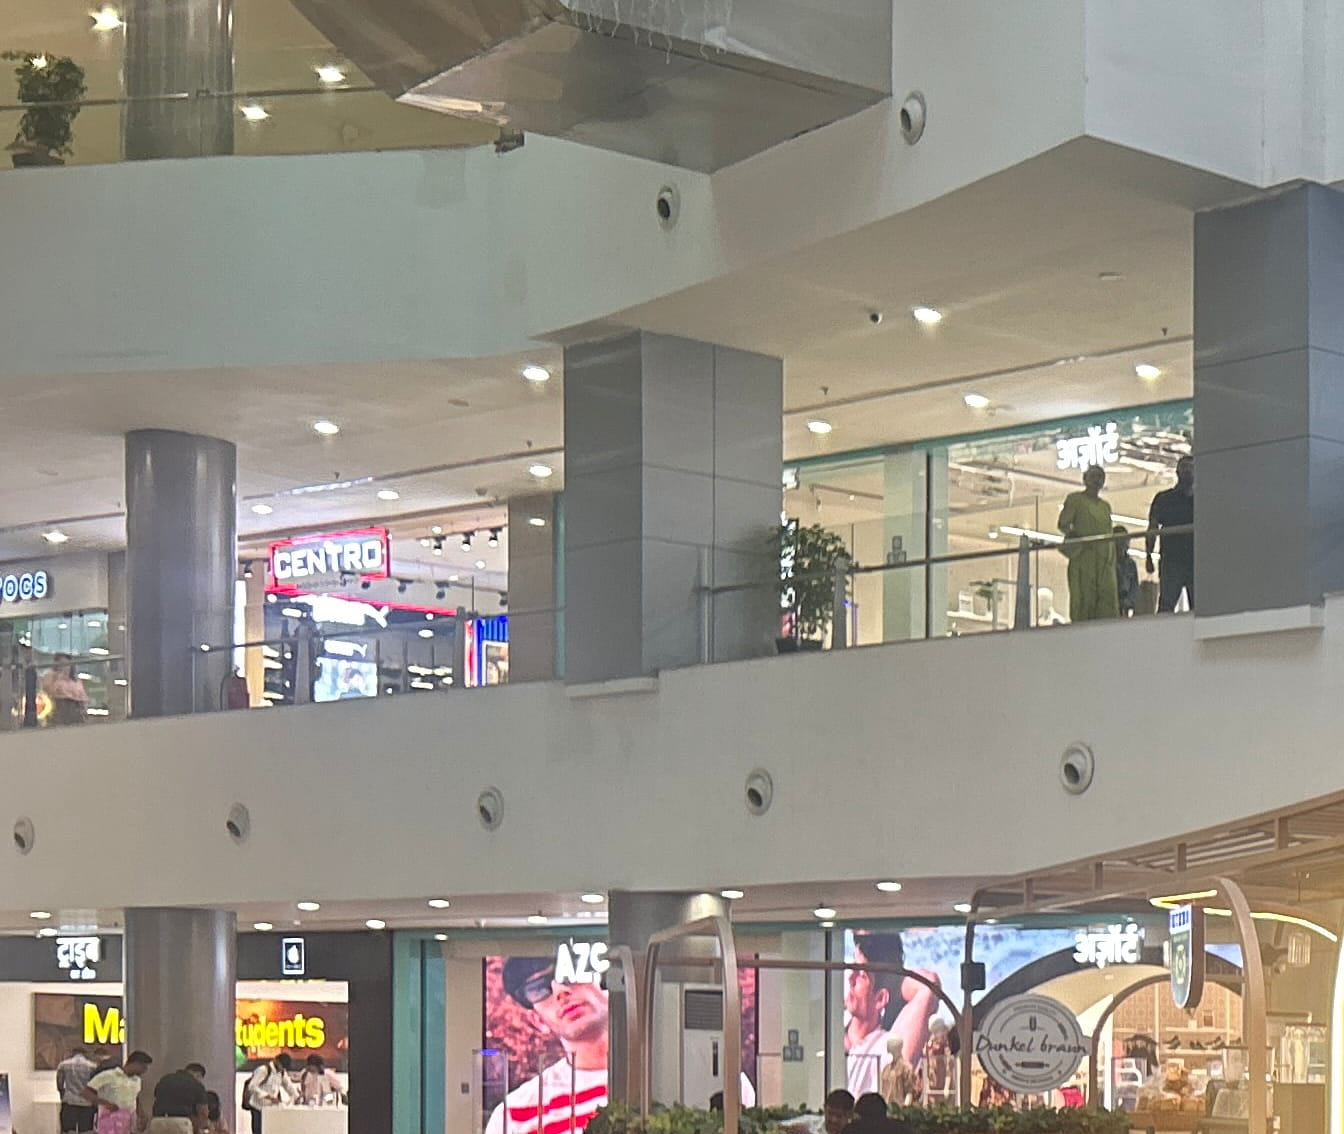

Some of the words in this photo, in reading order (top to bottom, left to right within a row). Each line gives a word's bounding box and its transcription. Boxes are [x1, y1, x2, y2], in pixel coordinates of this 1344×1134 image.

[274, 540, 383, 579] CENTRO
[0, 571, 47, 602] OCS
[236, 1013, 325, 1049] tudents
[976, 1034, 1034, 1053] Dunkel
